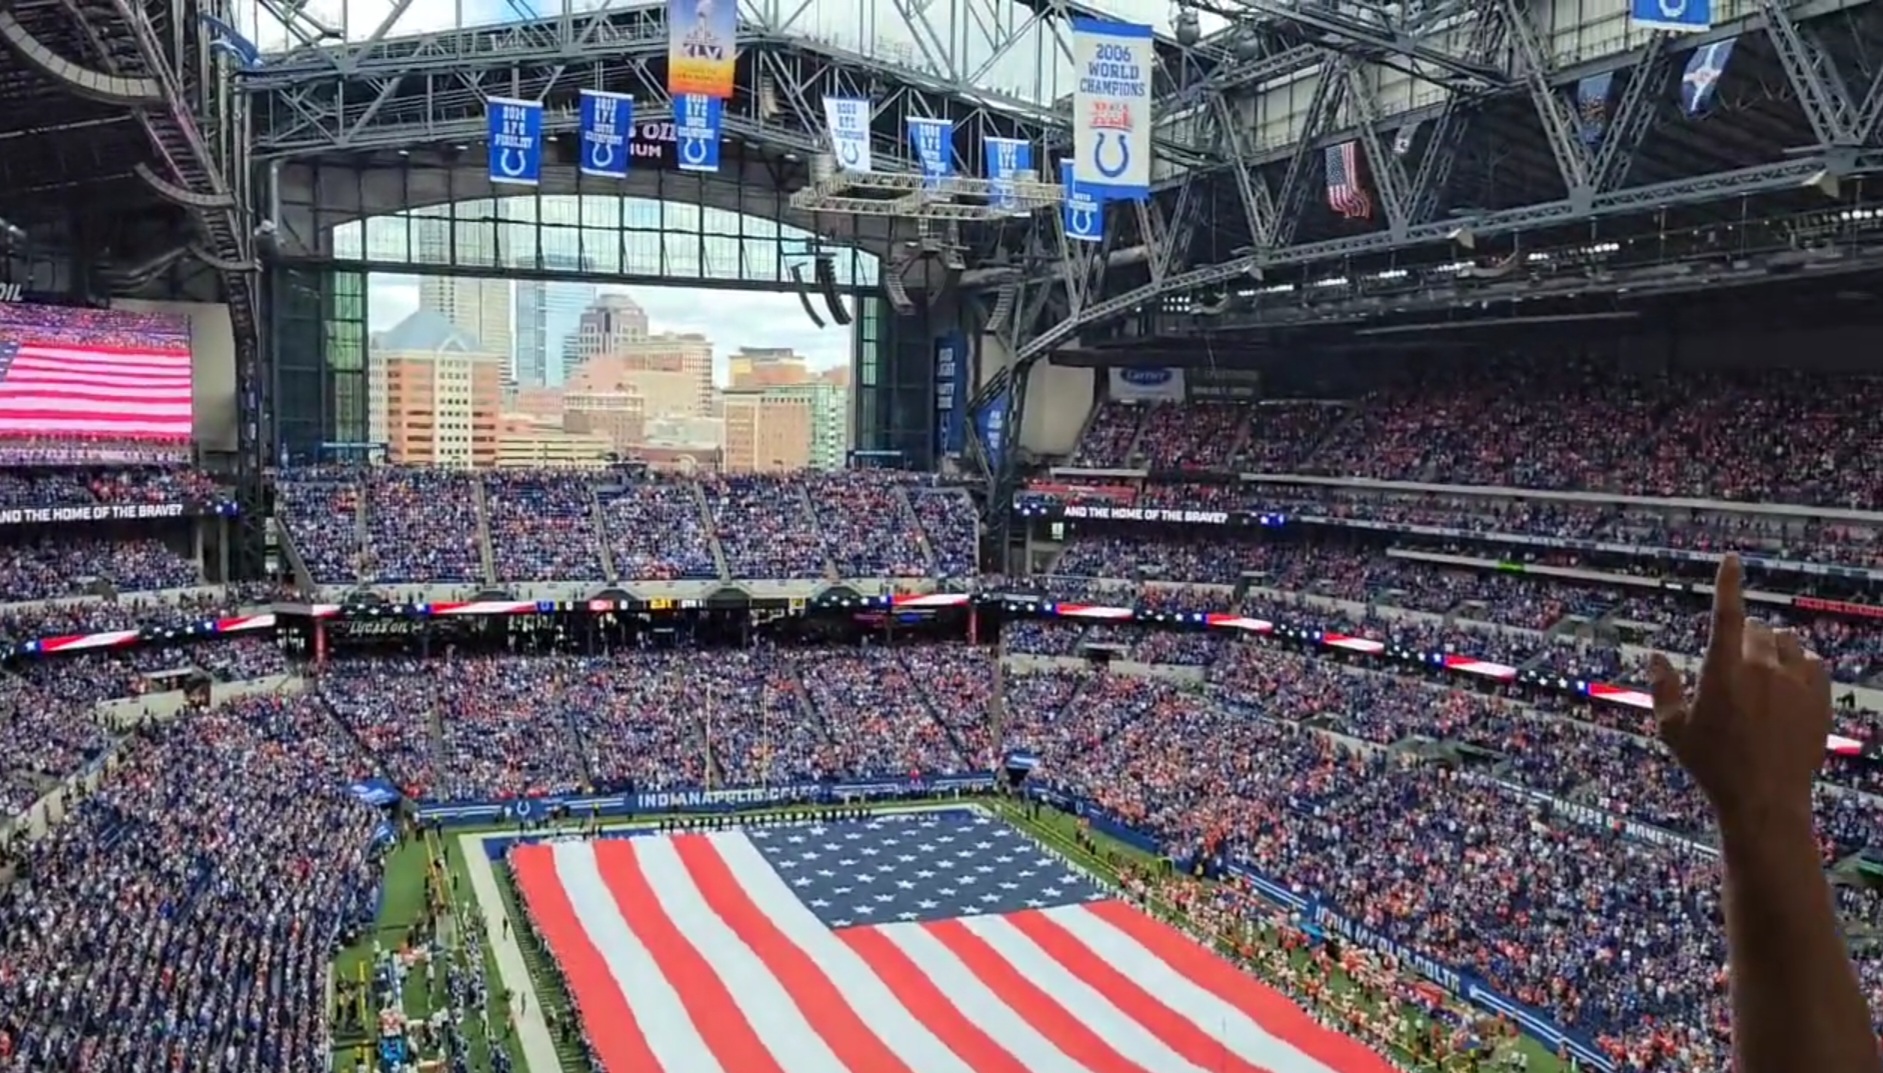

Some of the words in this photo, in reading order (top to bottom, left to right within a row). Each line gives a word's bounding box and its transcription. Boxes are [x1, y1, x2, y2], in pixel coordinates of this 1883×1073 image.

[1096, 43, 1131, 63] 2006
[1088, 62, 1139, 80] WORLD
[1080, 77, 1145, 97] CHAMPIONS
[24, 508, 50, 523] THE
[53, 507, 91, 522] HOME
[93, 506, 109, 519] OF
[112, 505, 136, 519] THE
[138, 503, 184, 518] BRAVE?
[1064, 506, 1087, 518] AND
[1089, 506, 1109, 519] THE
[1111, 508, 1143, 520] HOME
[1144, 509, 1160, 521] OF
[1161, 510, 1183, 522] THE
[1184, 511, 1228, 524] BRAVE?
[350, 621, 388, 637] LUCAS
[389, 621, 409, 634] OIL
